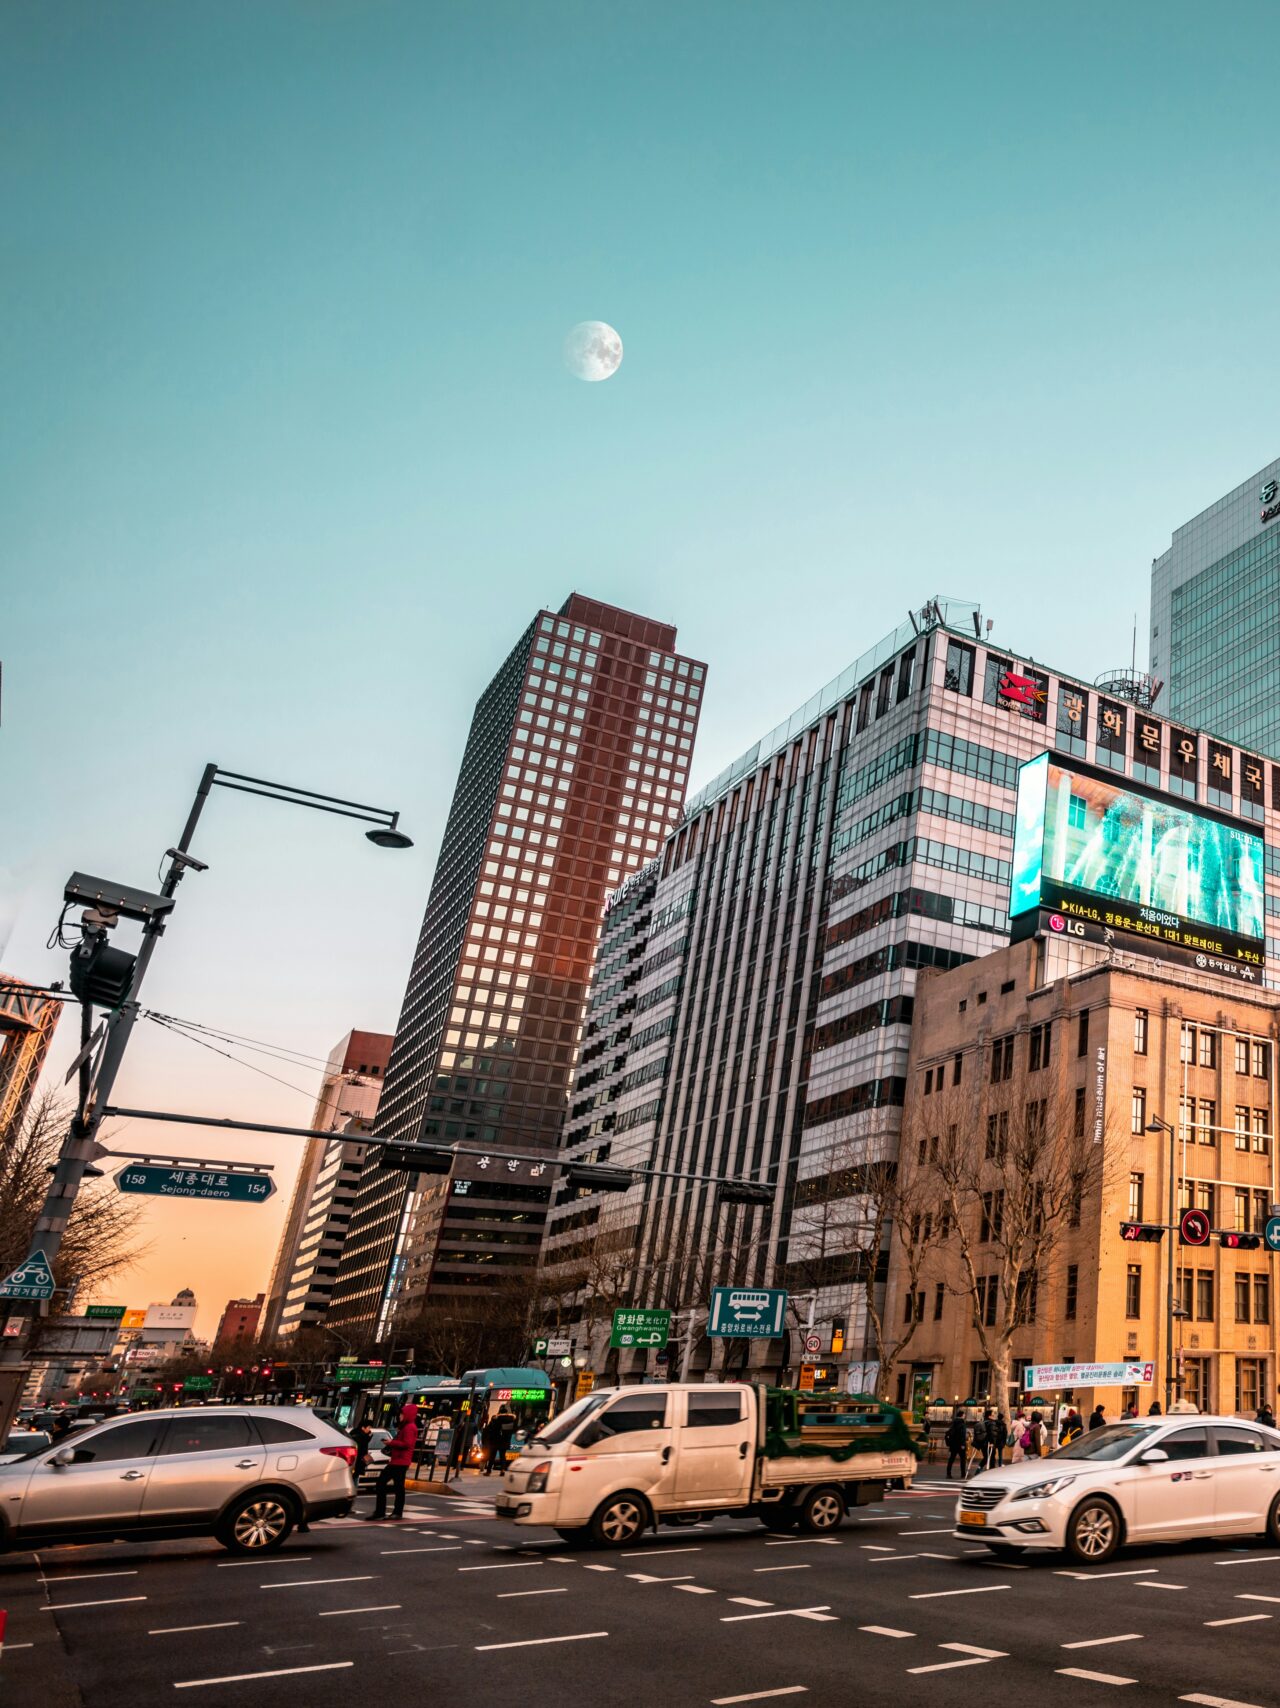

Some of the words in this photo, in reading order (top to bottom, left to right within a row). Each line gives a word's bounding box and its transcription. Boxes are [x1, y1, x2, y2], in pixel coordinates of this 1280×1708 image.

[1063, 693, 1262, 790] 광화문우체국
[1139, 907, 1180, 928] 처음이었다
[1066, 920, 1085, 936] LG
[1069, 903, 1101, 921] KIA-LG,
[1164, 929, 1181, 942] 1대1
[1184, 934, 1223, 953] 맞트레이드
[1244, 951, 1259, 965] 두산
[1208, 958, 1238, 974] 동아일보
[1097, 1047, 1106, 1060] art
[1096, 1061, 1104, 1072] of
[1096, 1075, 1104, 1117] museum
[125, 1174, 146, 1185] 158
[169, 1172, 229, 1186] 세종대로
[160, 1184, 230, 1198] Sejong-daero
[247, 1184, 266, 1194] 154
[617, 1314, 645, 1325] 광화문
[720, 1323, 771, 1334] 중앙차로버스전용
[535, 1341, 547, 1354] P
[808, 1340, 818, 1348] 50
[498, 1390, 512, 1400] 273
